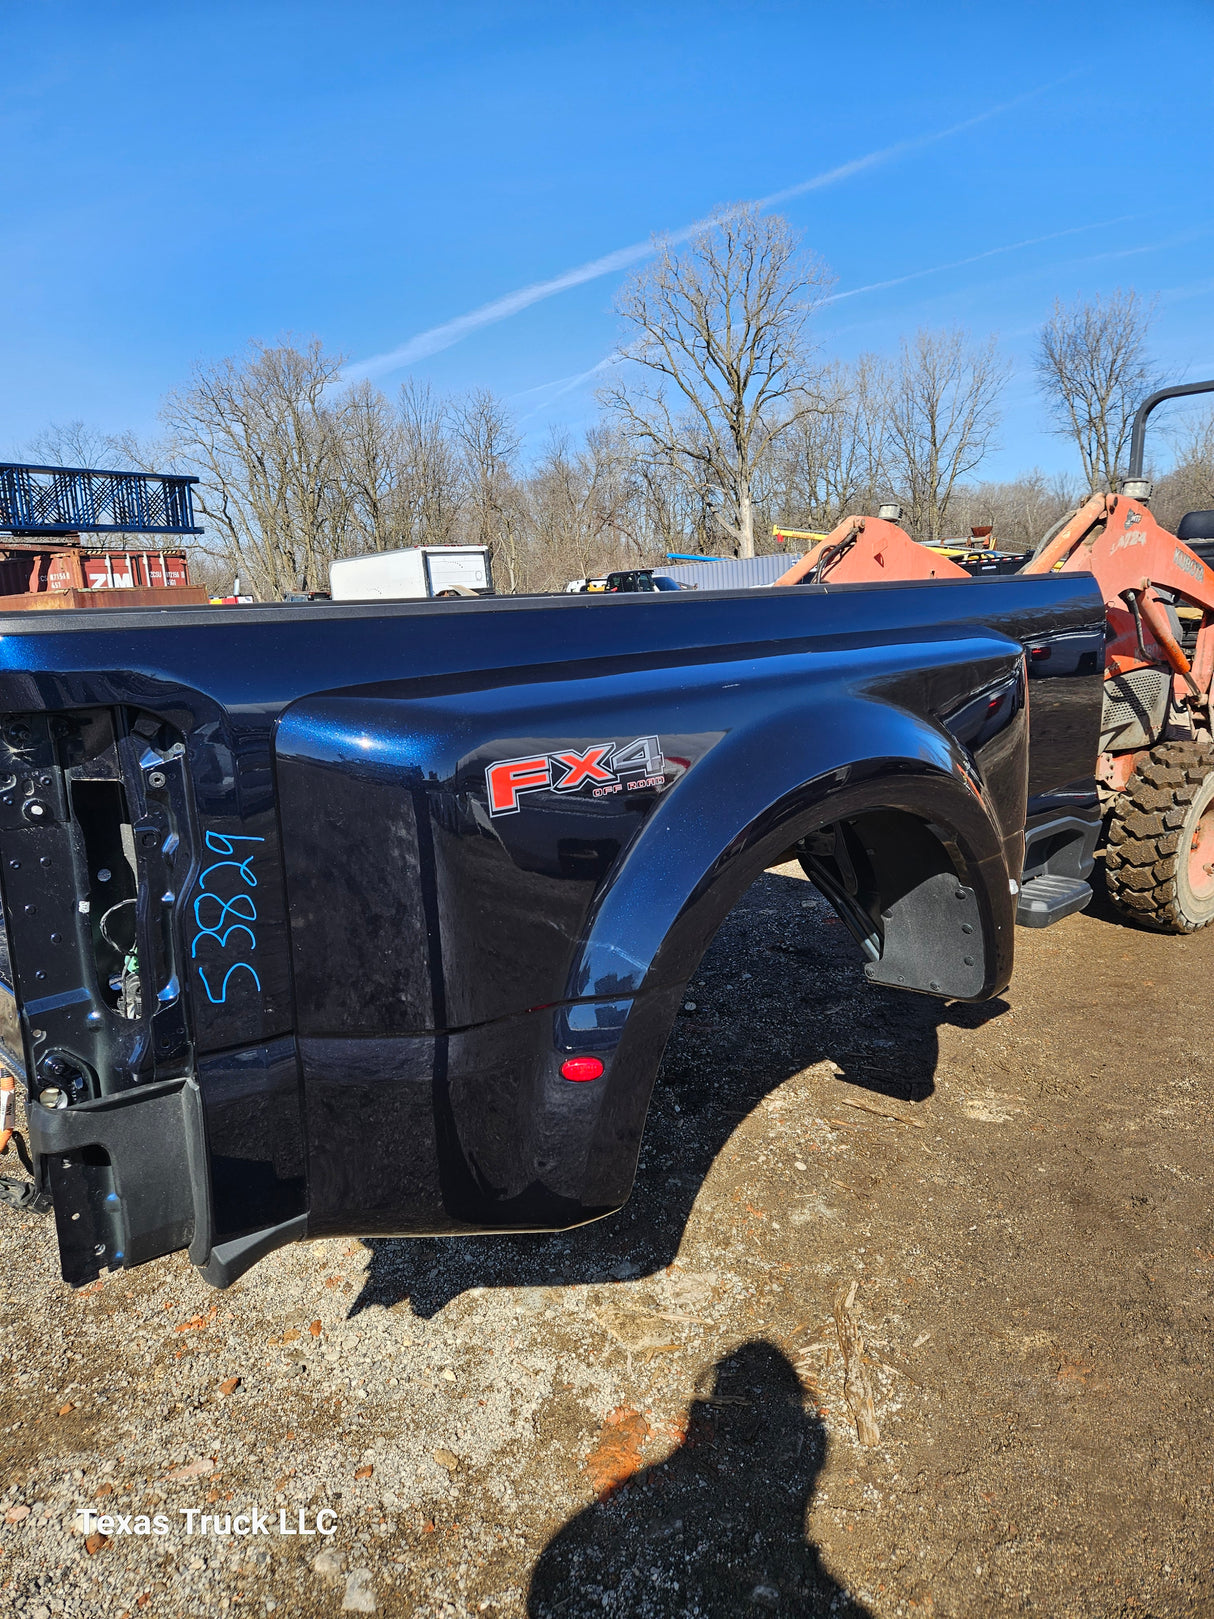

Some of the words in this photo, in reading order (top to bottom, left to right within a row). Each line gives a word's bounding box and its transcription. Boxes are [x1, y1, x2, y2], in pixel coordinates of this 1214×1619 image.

[89, 574, 133, 588] ZIM
[1173, 546, 1204, 583] KUBOTA
[485, 735, 666, 818] FX4
[592, 784, 623, 797] OFF
[627, 775, 665, 791] ROAD
[191, 830, 265, 1004] 53829
